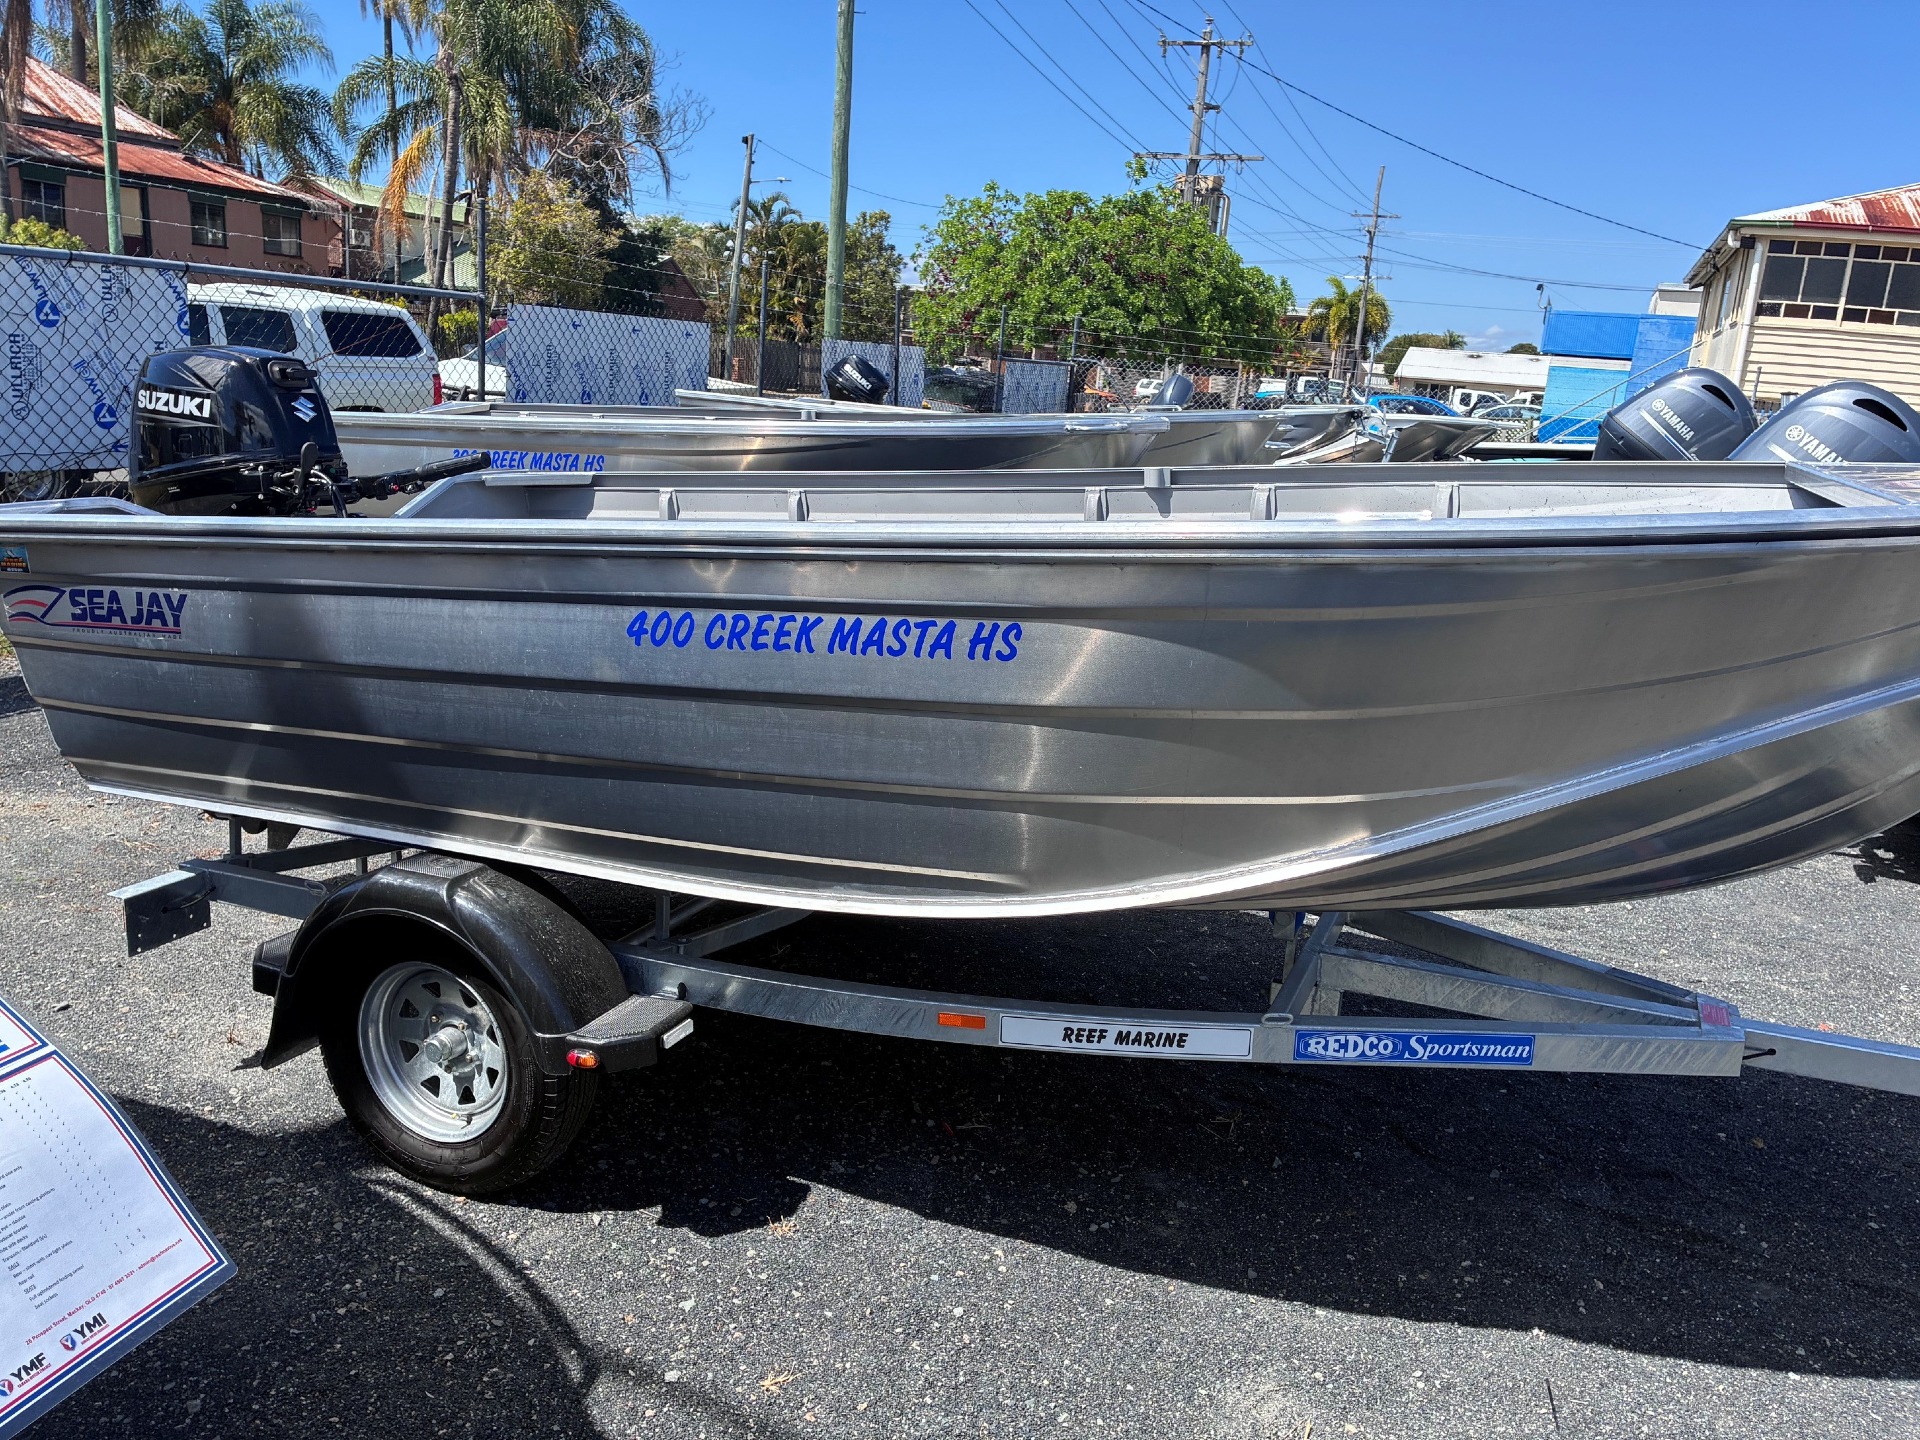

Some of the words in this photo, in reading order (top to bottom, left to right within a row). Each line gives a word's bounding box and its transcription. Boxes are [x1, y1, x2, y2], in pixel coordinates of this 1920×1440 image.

[843, 364, 872, 390] SUZUKI
[138, 389, 211, 418] SUZUKI
[1660, 405, 1695, 441] YAMAHA
[486, 450, 528, 469] REEK
[530, 451, 580, 472] MASTA
[583, 454, 605, 472] HS
[1797, 433, 1847, 462] YAMA
[69, 589, 127, 624] SEA
[130, 592, 187, 627] JAY
[626, 610, 695, 648] 400
[704, 613, 824, 654] CREEK
[827, 617, 957, 660] MASTA
[966, 622, 1022, 662] HS
[1062, 1027, 1108, 1044] REEF
[1114, 1030, 1188, 1049] MARINE
[1308, 1035, 1394, 1058] REDCO
[1404, 1035, 1530, 1061] Sportsman
[73, 1312, 107, 1339] YMI
[9, 1352, 46, 1381] YMF
